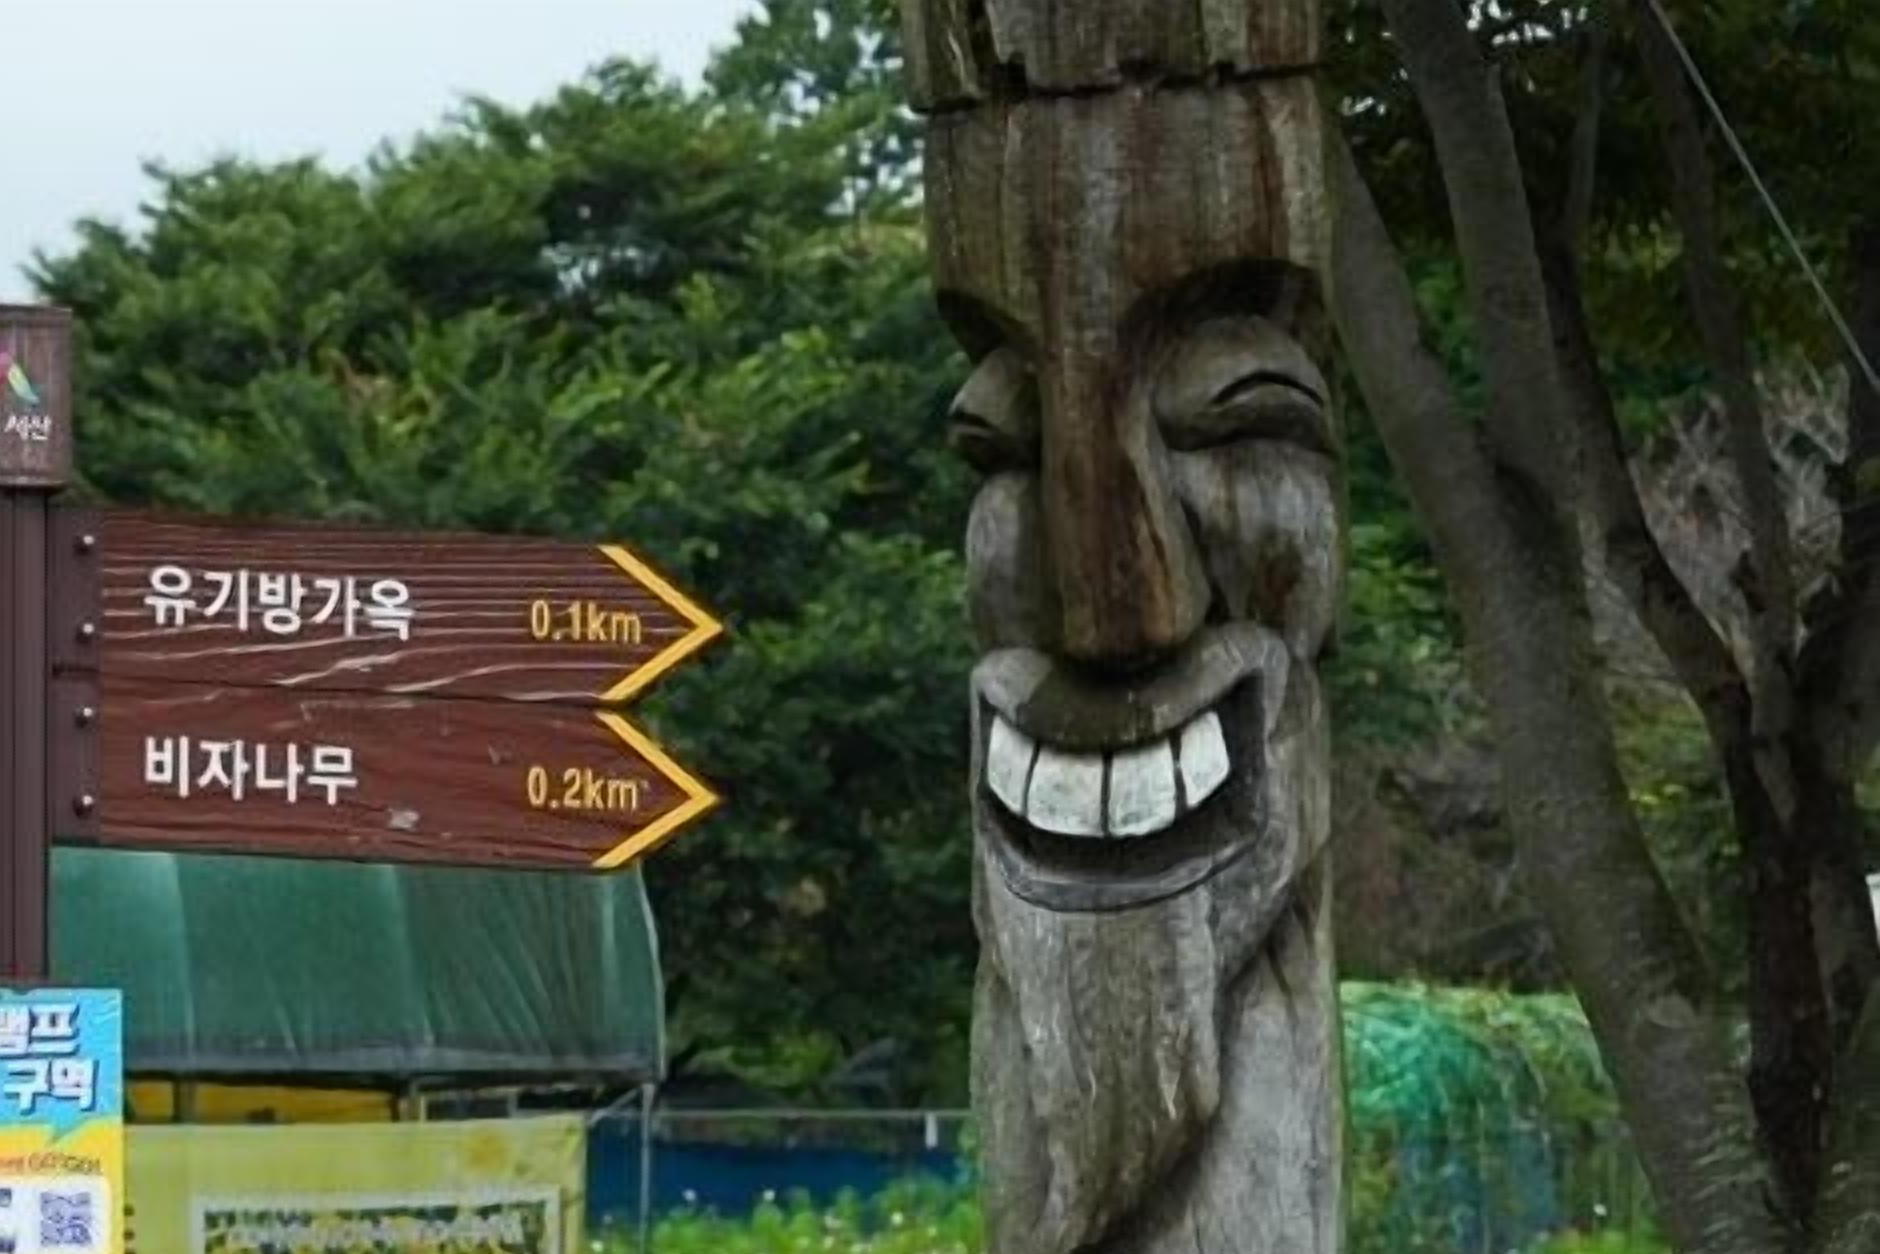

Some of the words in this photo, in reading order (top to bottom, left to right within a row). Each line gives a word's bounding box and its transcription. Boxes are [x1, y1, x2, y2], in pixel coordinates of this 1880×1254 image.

[144, 564, 417, 642] 유기방가옥
[530, 600, 642, 645] 0.1km
[144, 734, 359, 807] 비자나무
[527, 765, 639, 810] 0.2km
[4, 1058, 99, 1116] 구역
